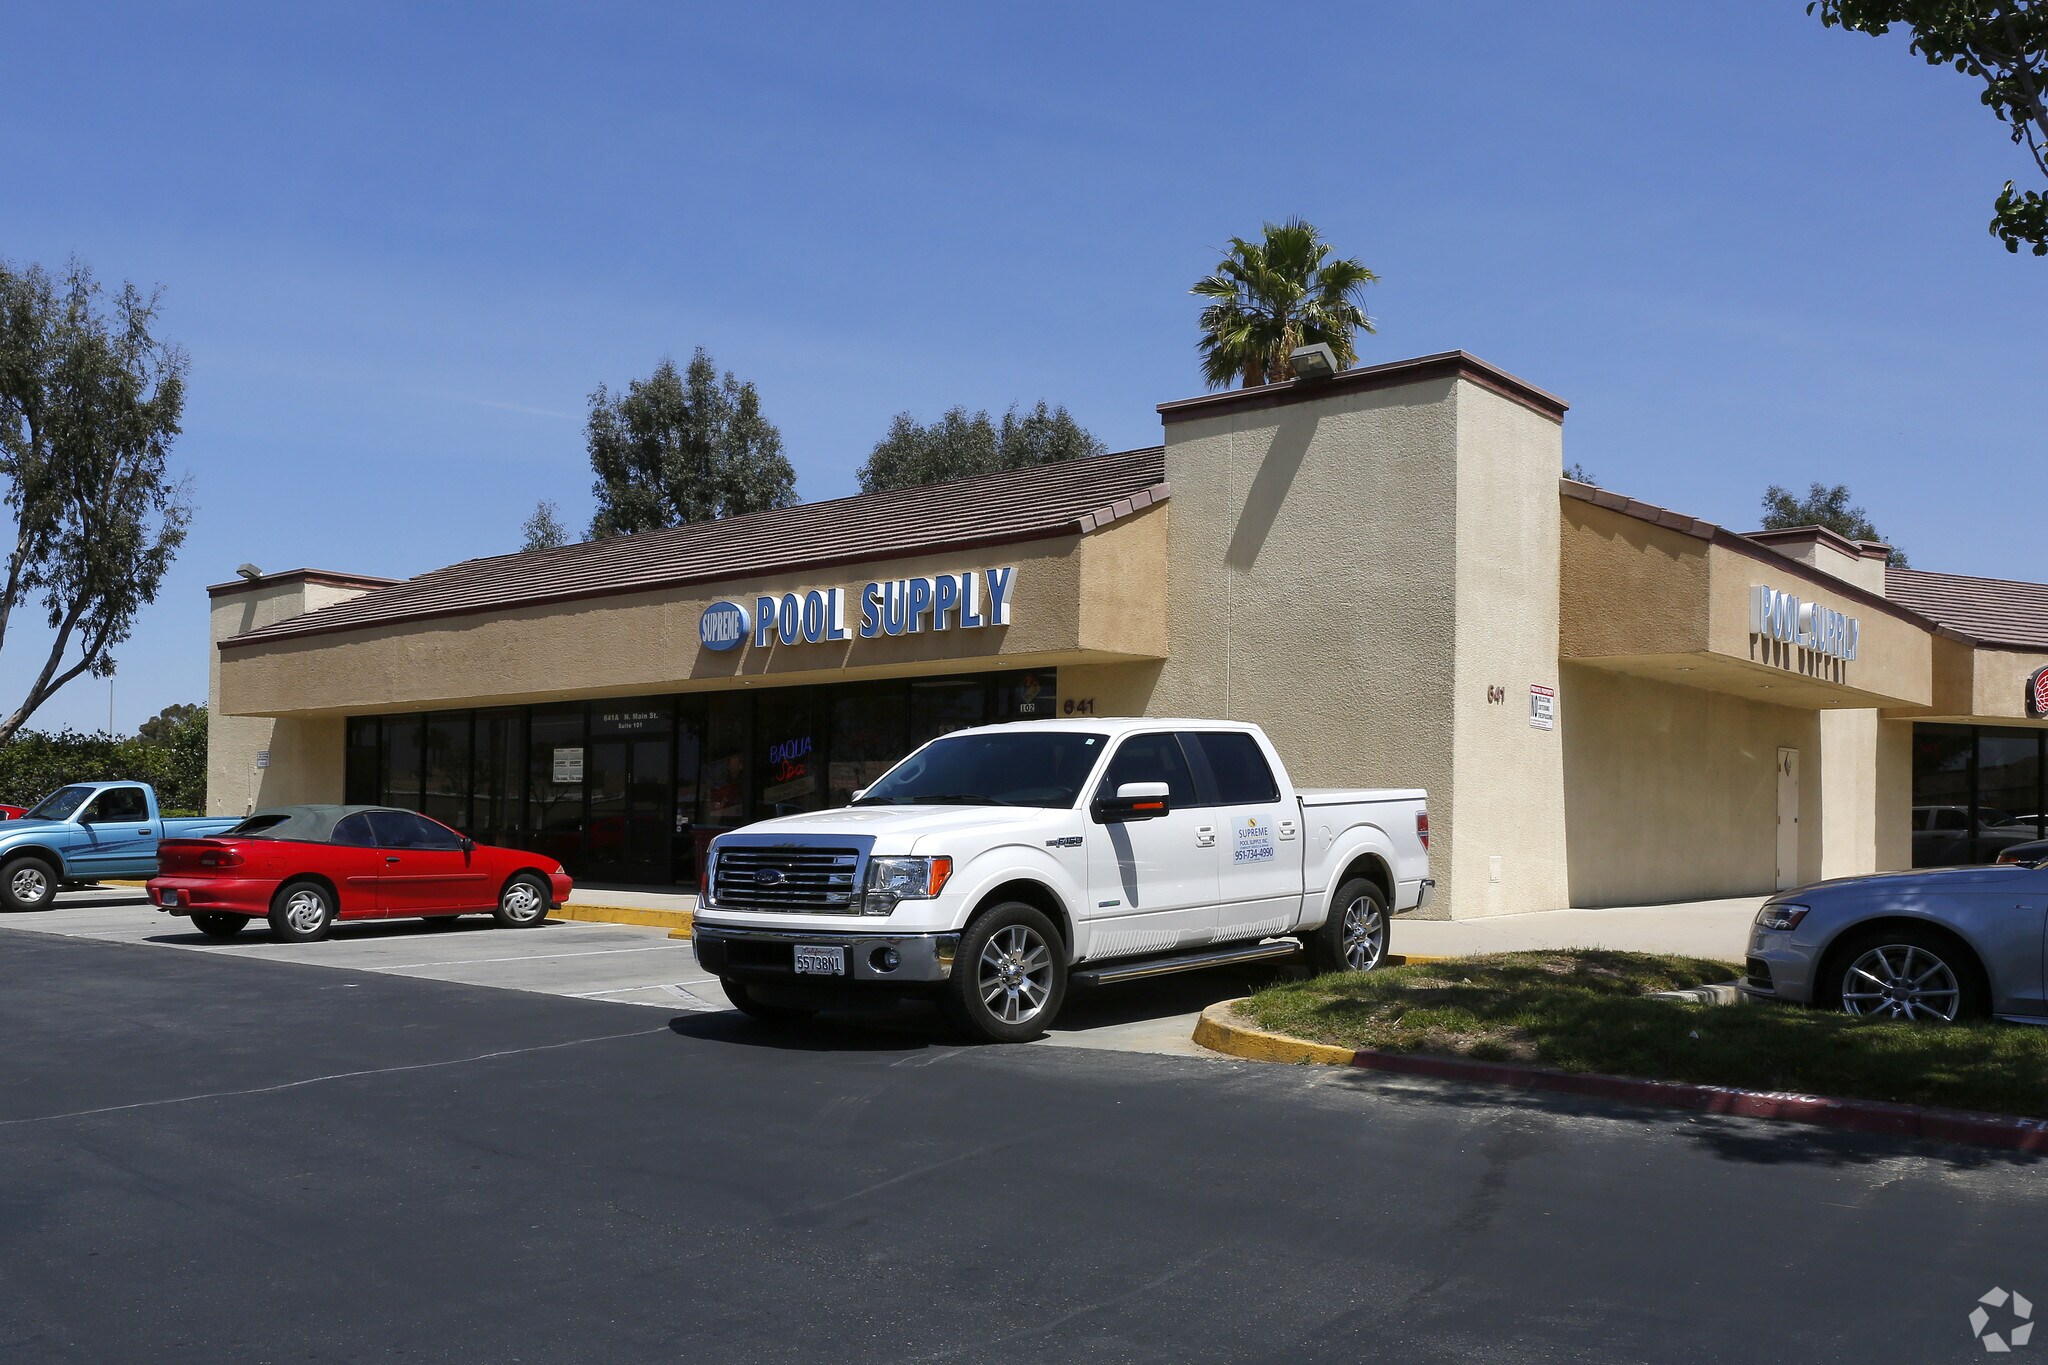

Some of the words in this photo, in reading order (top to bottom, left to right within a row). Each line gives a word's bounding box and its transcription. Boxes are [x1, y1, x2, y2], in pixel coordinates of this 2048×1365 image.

[702, 610, 740, 642] SUPREME
[755, 588, 852, 648] POOL
[860, 567, 1018, 639] SUPPLY
[1752, 585, 1810, 648] POOL
[1804, 602, 1859, 661] SUPPLY
[1487, 684, 1505, 706] 641
[1063, 698, 1095, 715] 641
[770, 736, 812, 764] BAQUA
[776, 759, 805, 781] Spa
[1239, 827, 1268, 838] SUPREME
[1235, 847, 1273, 860] 951-734-4990
